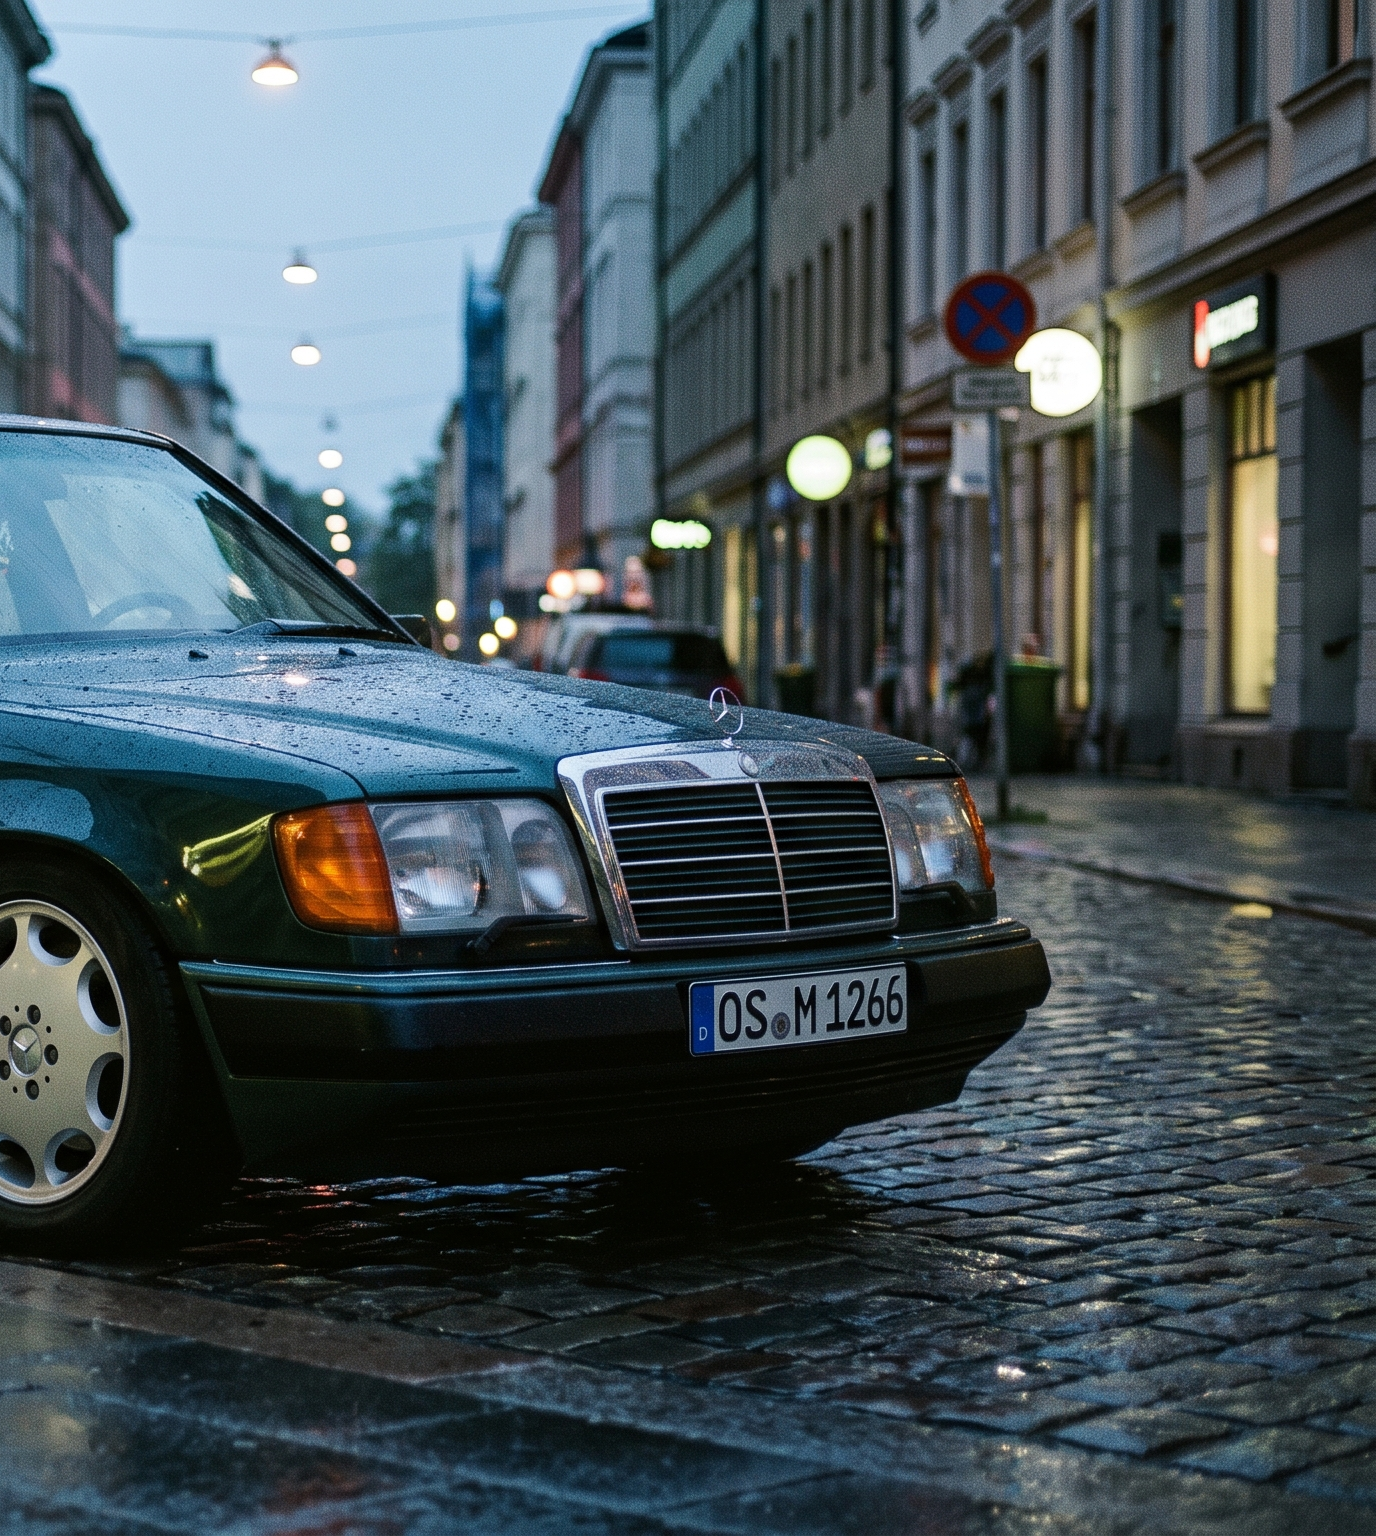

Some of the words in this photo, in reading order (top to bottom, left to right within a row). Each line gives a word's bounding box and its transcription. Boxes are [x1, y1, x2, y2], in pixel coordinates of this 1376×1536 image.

[719, 989, 768, 1042] OS
[794, 985, 817, 1036] M
[826, 975, 904, 1032] 1266
[699, 1026, 708, 1041] D
